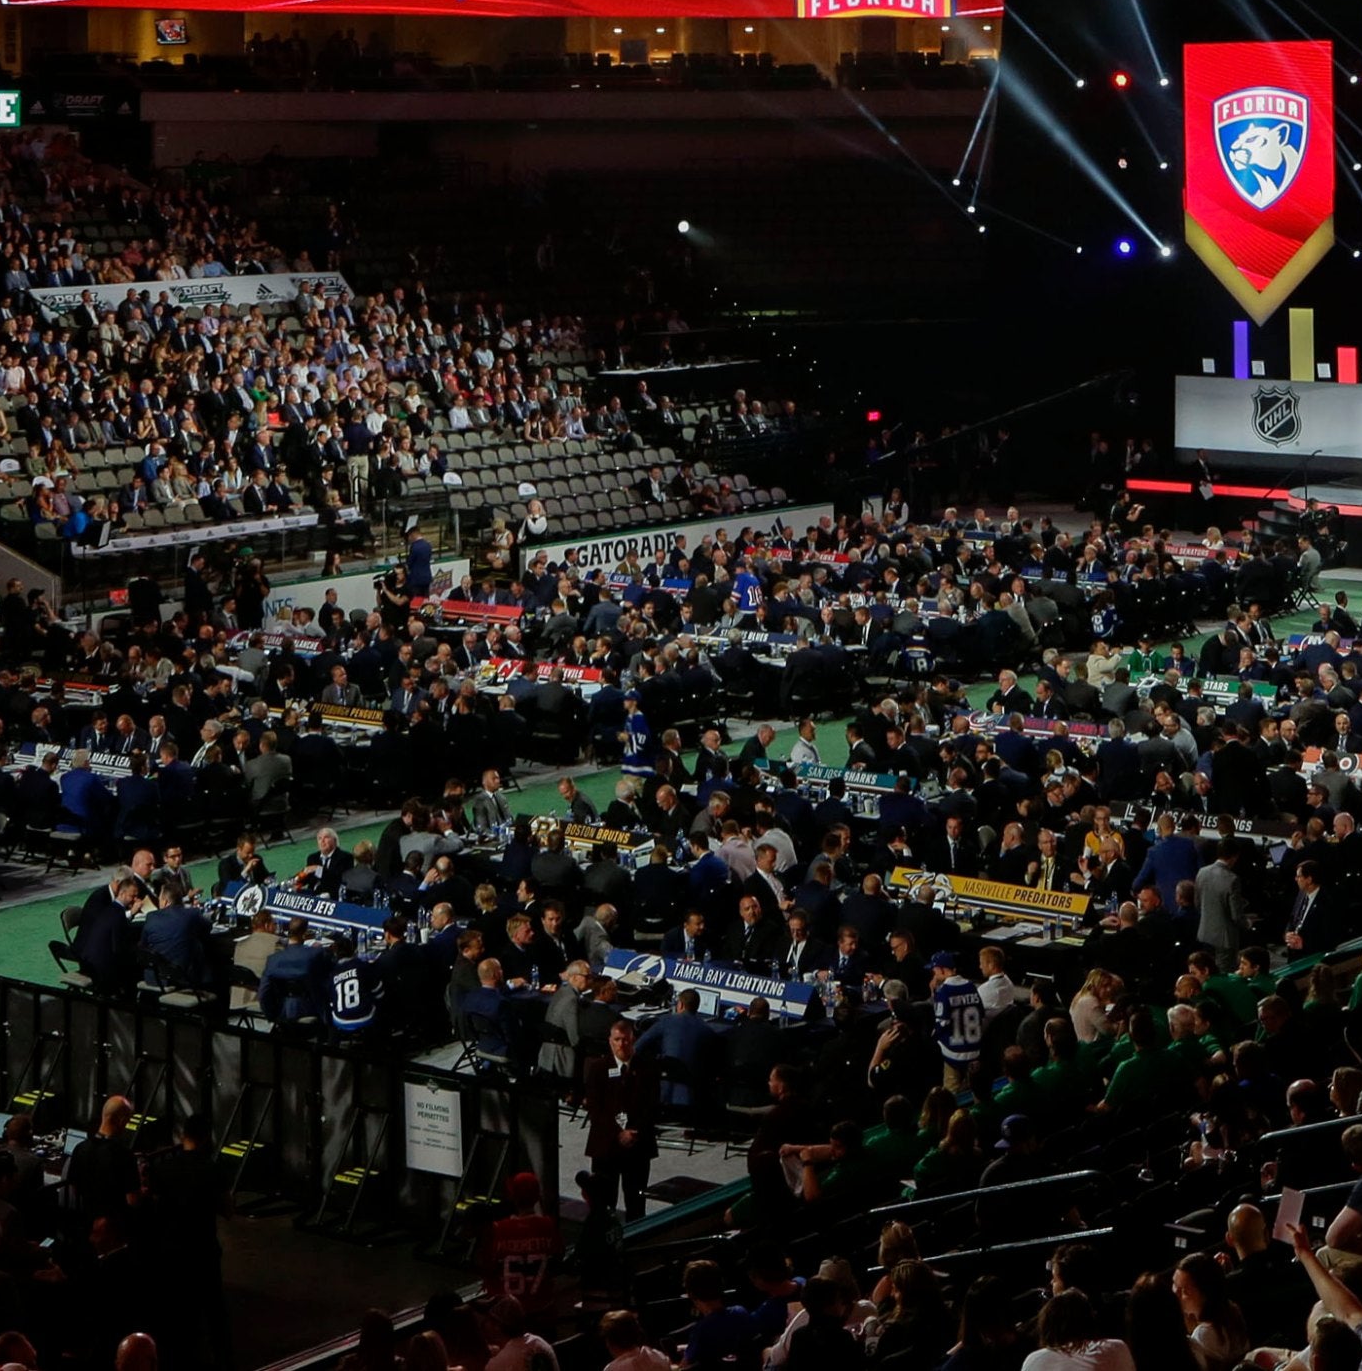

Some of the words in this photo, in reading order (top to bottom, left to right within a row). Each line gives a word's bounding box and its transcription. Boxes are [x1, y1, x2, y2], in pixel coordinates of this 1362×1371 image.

[1222, 96, 1298, 118] FLORIDA
[182, 284, 223, 297] DRAFT
[1263, 403, 1291, 433] NHL
[577, 532, 678, 567] GATORADE
[1203, 681, 1229, 692] STARS
[91, 751, 116, 767] MAPLE
[807, 766, 824, 779] SAN
[824, 769, 843, 781] JOSE
[843, 771, 879, 786] SHARKS
[565, 822, 596, 838] BOSTON
[595, 827, 632, 845] BRUINS
[273, 891, 316, 911] WINNIPEG
[316, 901, 337, 917] JETS
[962, 880, 1013, 900] NASHVILLE
[1013, 887, 1073, 910] PREDATORS
[672, 962, 704, 980] TAMPA
[704, 969, 726, 984] BAY
[725, 972, 787, 997] LIGHTNING
[336, 978, 360, 1013] 18
[950, 1006, 981, 1040] 18
[503, 1254, 548, 1295] 67
